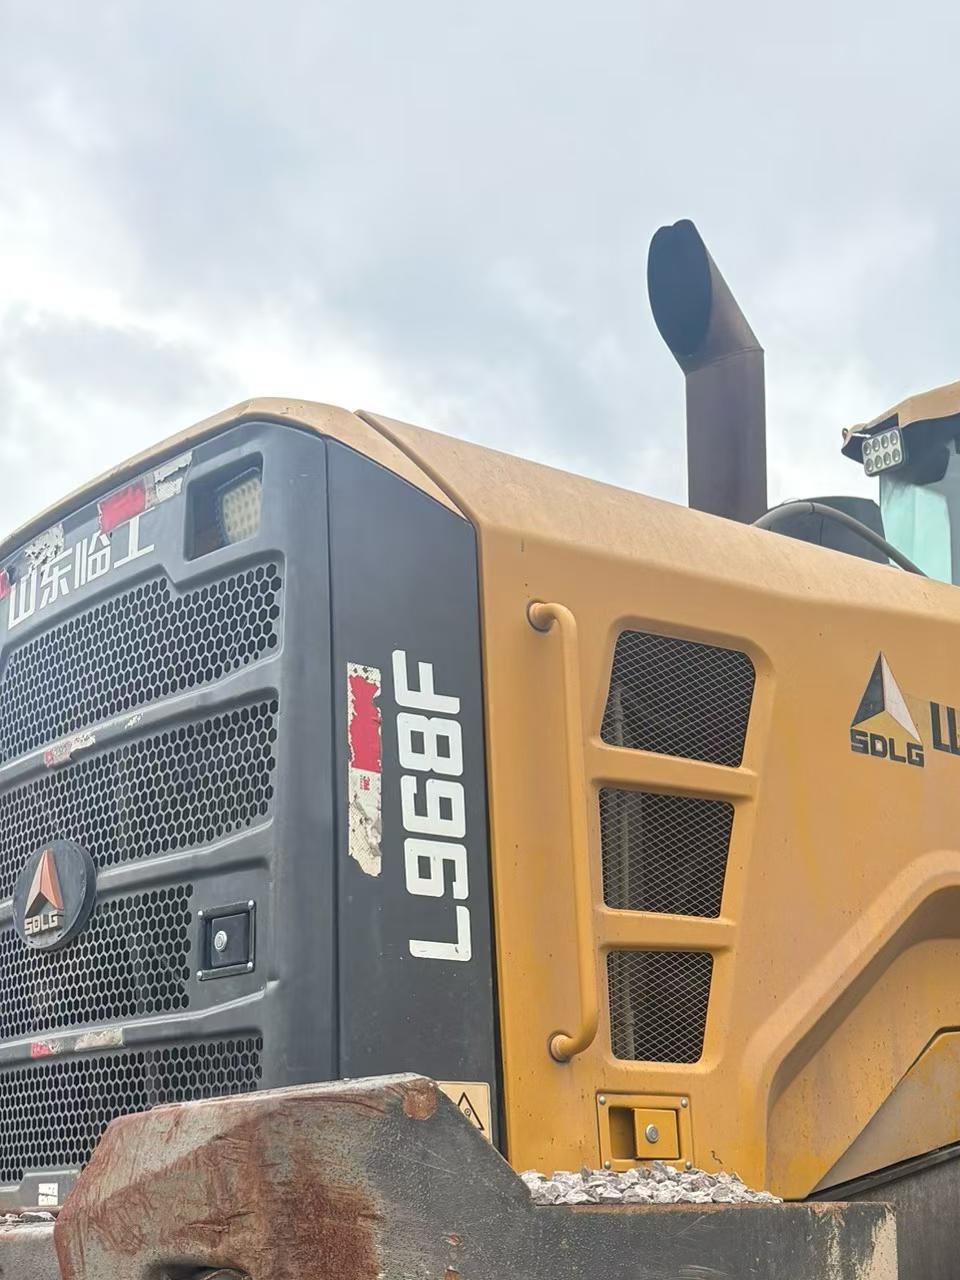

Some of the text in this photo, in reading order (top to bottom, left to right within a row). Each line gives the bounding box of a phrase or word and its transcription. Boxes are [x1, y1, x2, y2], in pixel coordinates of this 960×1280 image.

[8, 506, 155, 630] 山东临工
[851, 728, 925, 768] SDLG
[392, 649, 472, 962] L968F
[24, 910, 60, 936] SDLG
